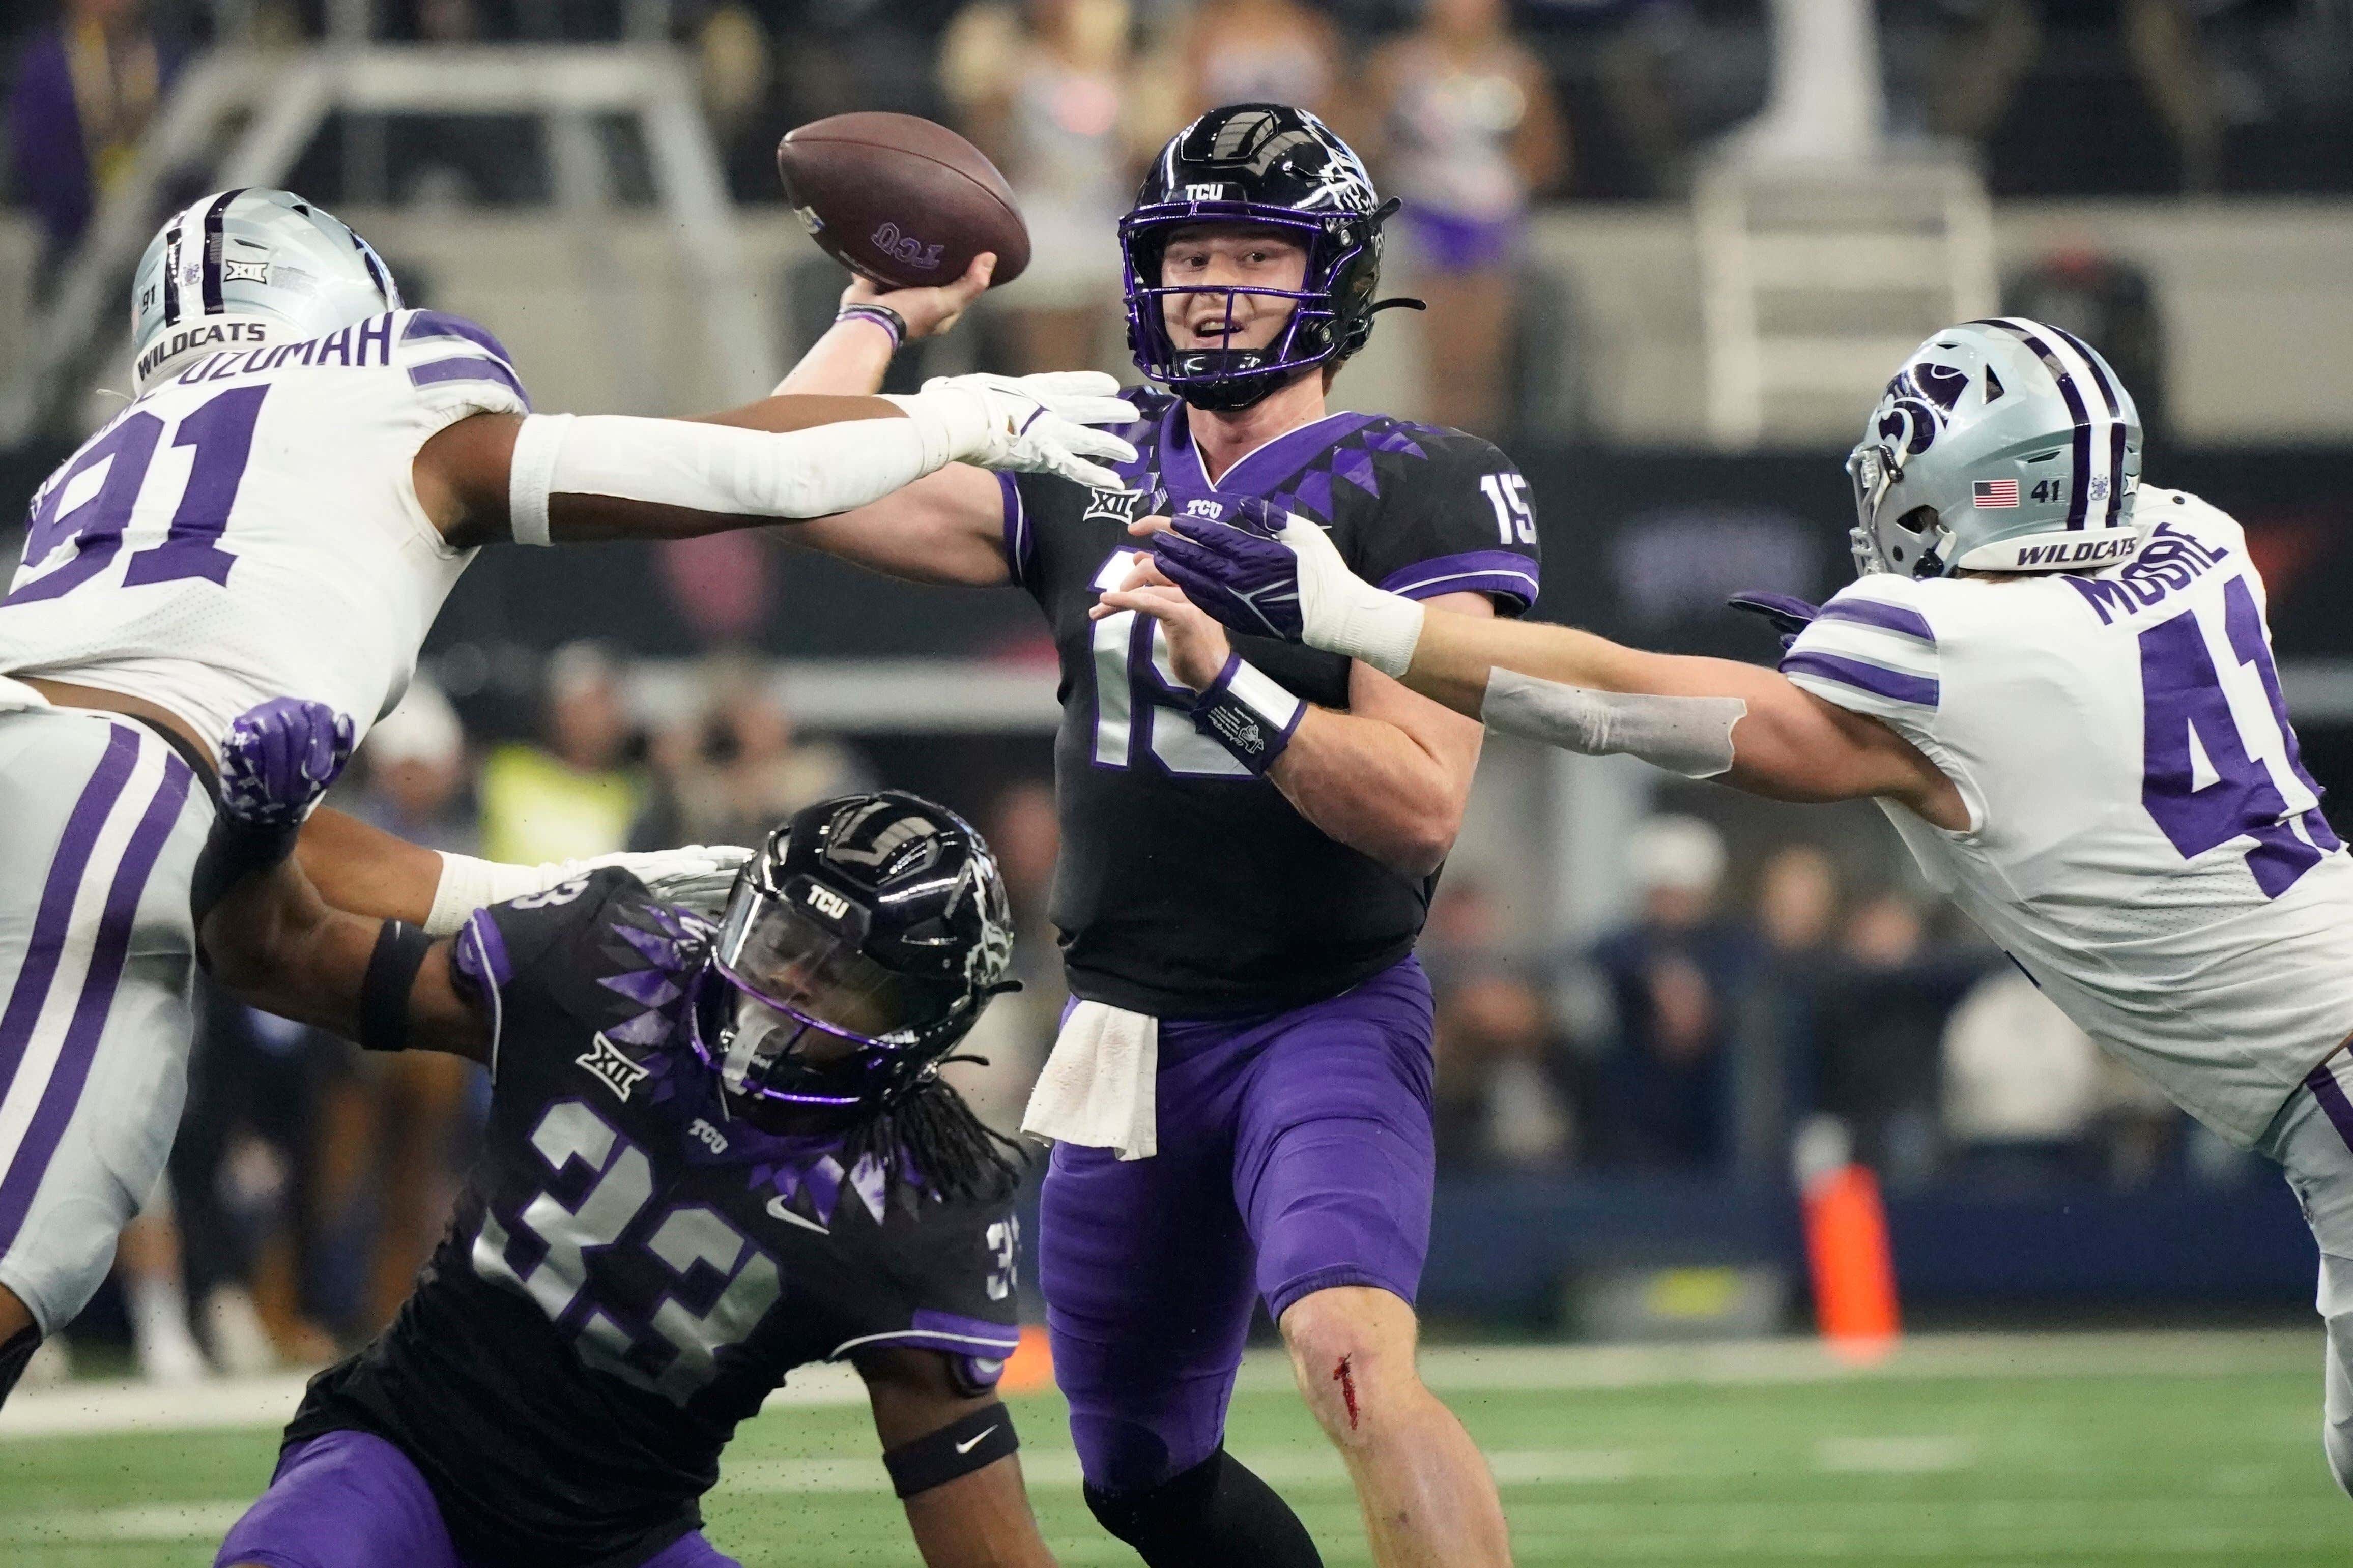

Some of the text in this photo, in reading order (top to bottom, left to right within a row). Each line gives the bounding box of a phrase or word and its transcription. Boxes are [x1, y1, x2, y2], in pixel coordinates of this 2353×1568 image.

[1186, 184, 1223, 200] TCU
[870, 222, 945, 269] TCU
[142, 284, 156, 315] 91
[137, 322, 267, 382] WILDCATS
[0, 383, 272, 608] 91
[1187, 499, 1223, 519] TCU
[1480, 471, 1537, 545] 15
[2030, 479, 2061, 503] 41
[2017, 537, 2137, 566] WILDCATS
[2059, 521, 2230, 626] MOORE
[2137, 573, 2343, 900] 41
[807, 884, 849, 919] TCU
[688, 1118, 728, 1154] TCU
[471, 1100, 783, 1408] 33
